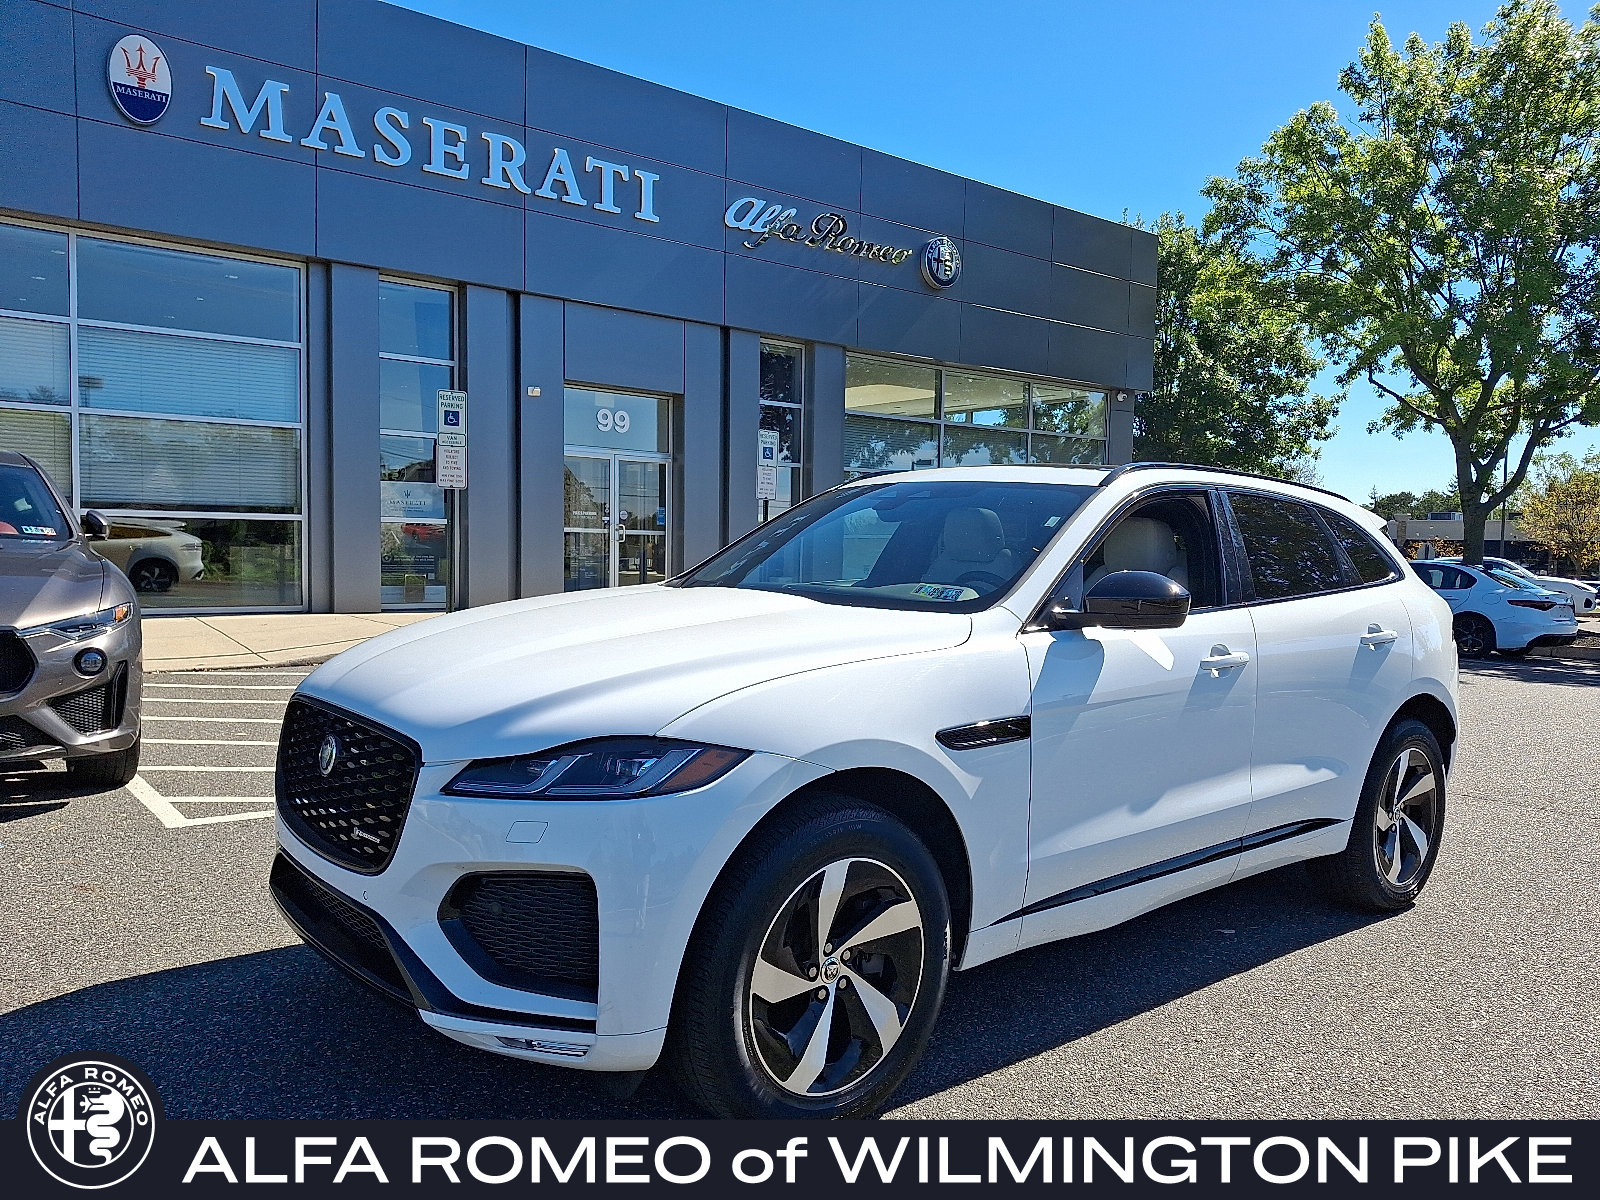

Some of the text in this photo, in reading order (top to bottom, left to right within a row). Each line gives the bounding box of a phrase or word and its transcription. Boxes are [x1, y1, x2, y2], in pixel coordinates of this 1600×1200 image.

[115, 84, 167, 103] MASERATI
[199, 65, 661, 223] MASERATI
[805, 212, 913, 265] Romeo
[440, 393, 464, 402] RESERVED
[441, 402, 463, 410] PARKING
[596, 408, 630, 434] 99
